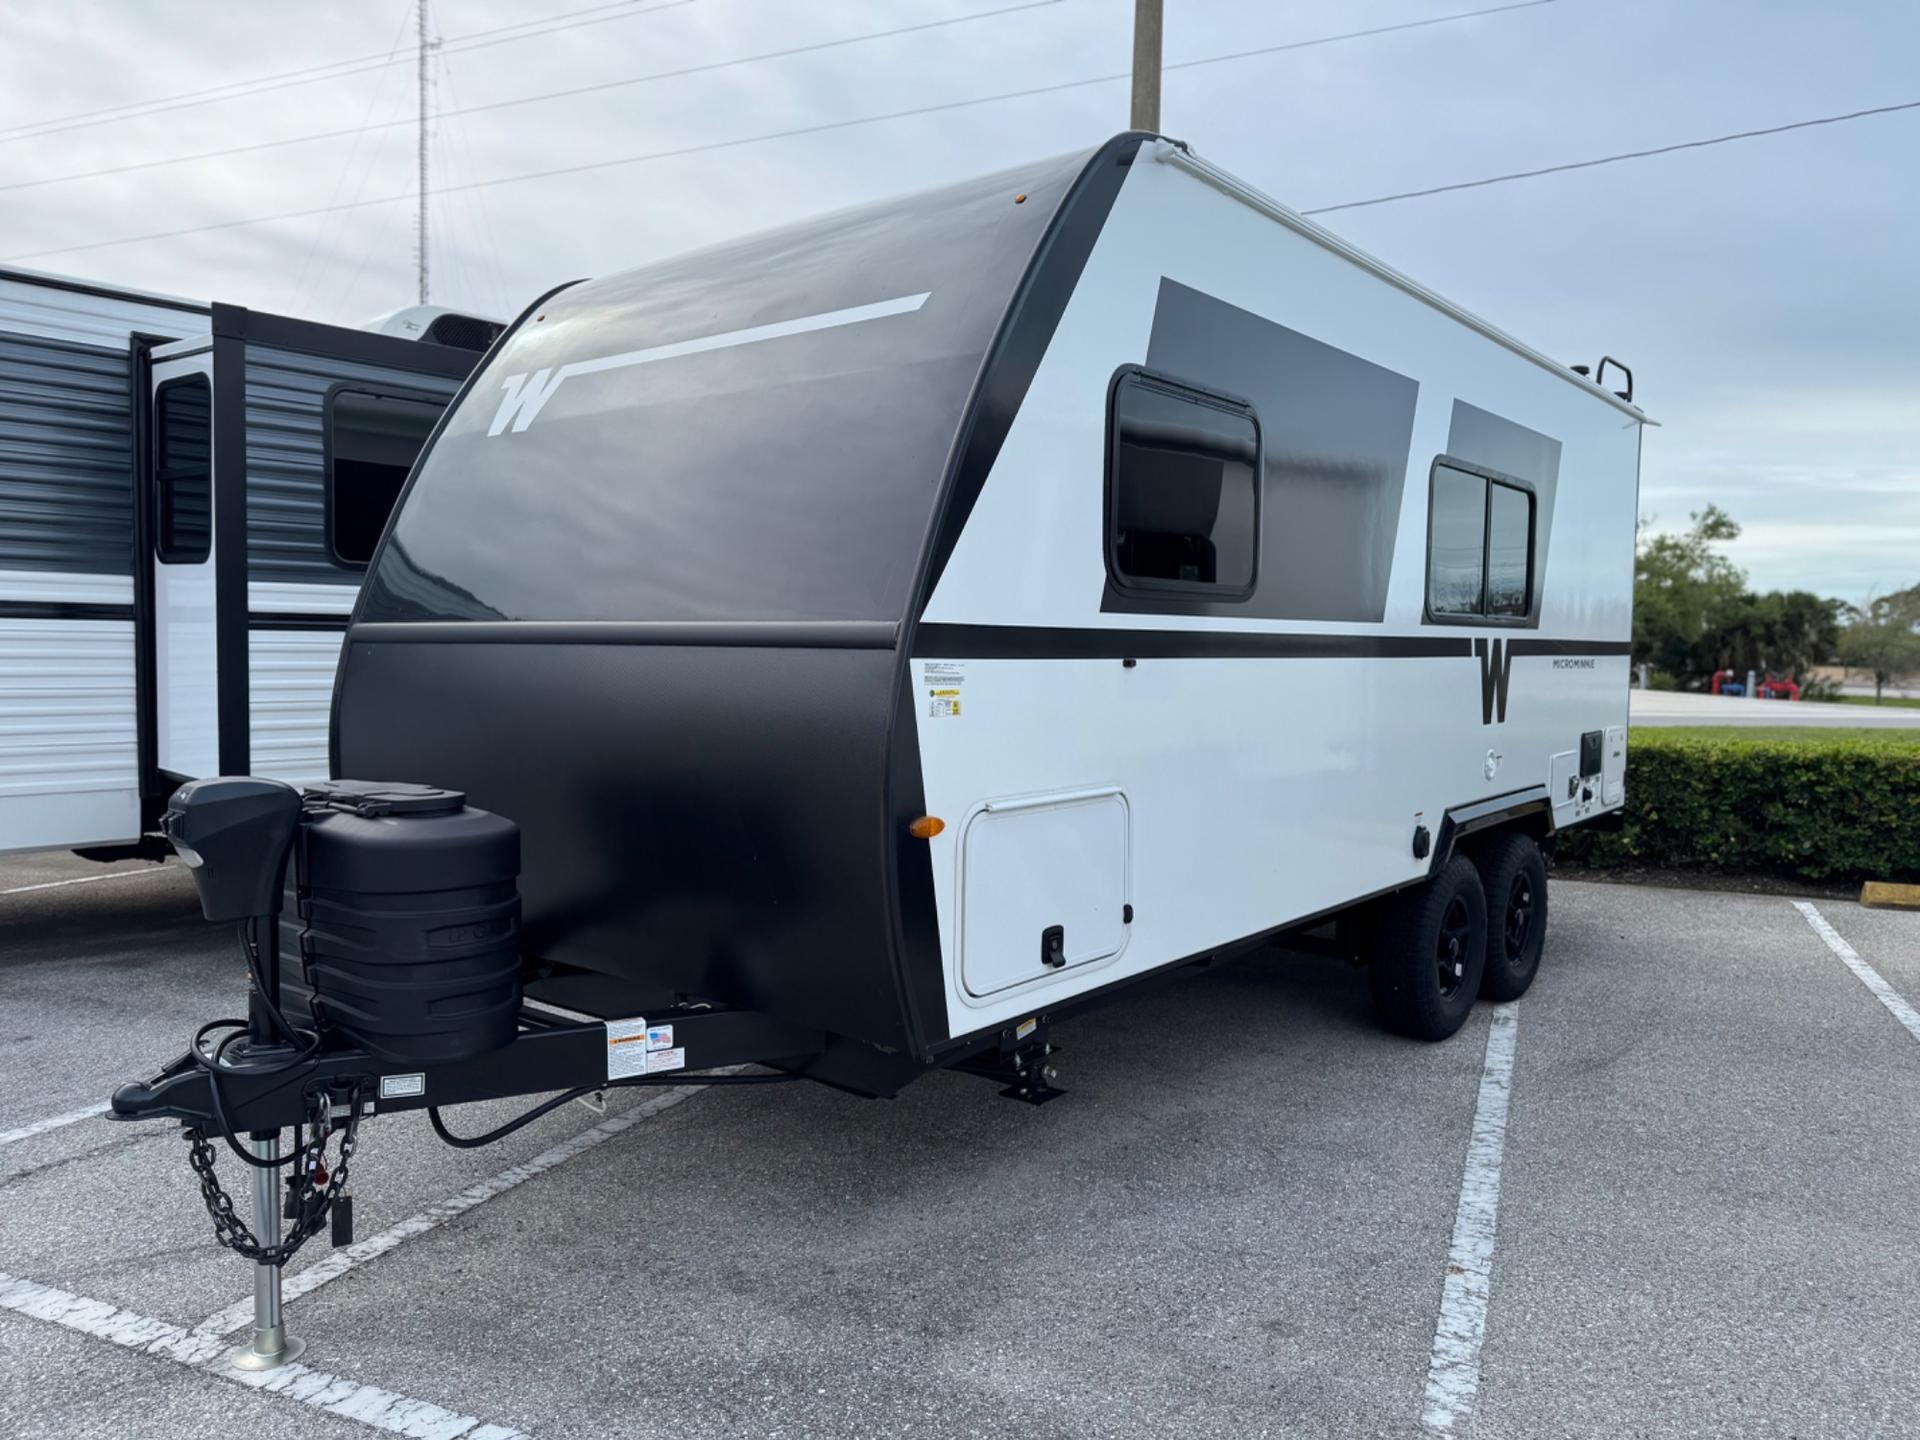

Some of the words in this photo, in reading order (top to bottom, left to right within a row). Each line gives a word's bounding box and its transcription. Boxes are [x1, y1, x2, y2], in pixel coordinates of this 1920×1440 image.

[488, 367, 566, 437] W
[1475, 638, 1511, 724] W
[1553, 658, 1595, 669] MICROMINNIE
